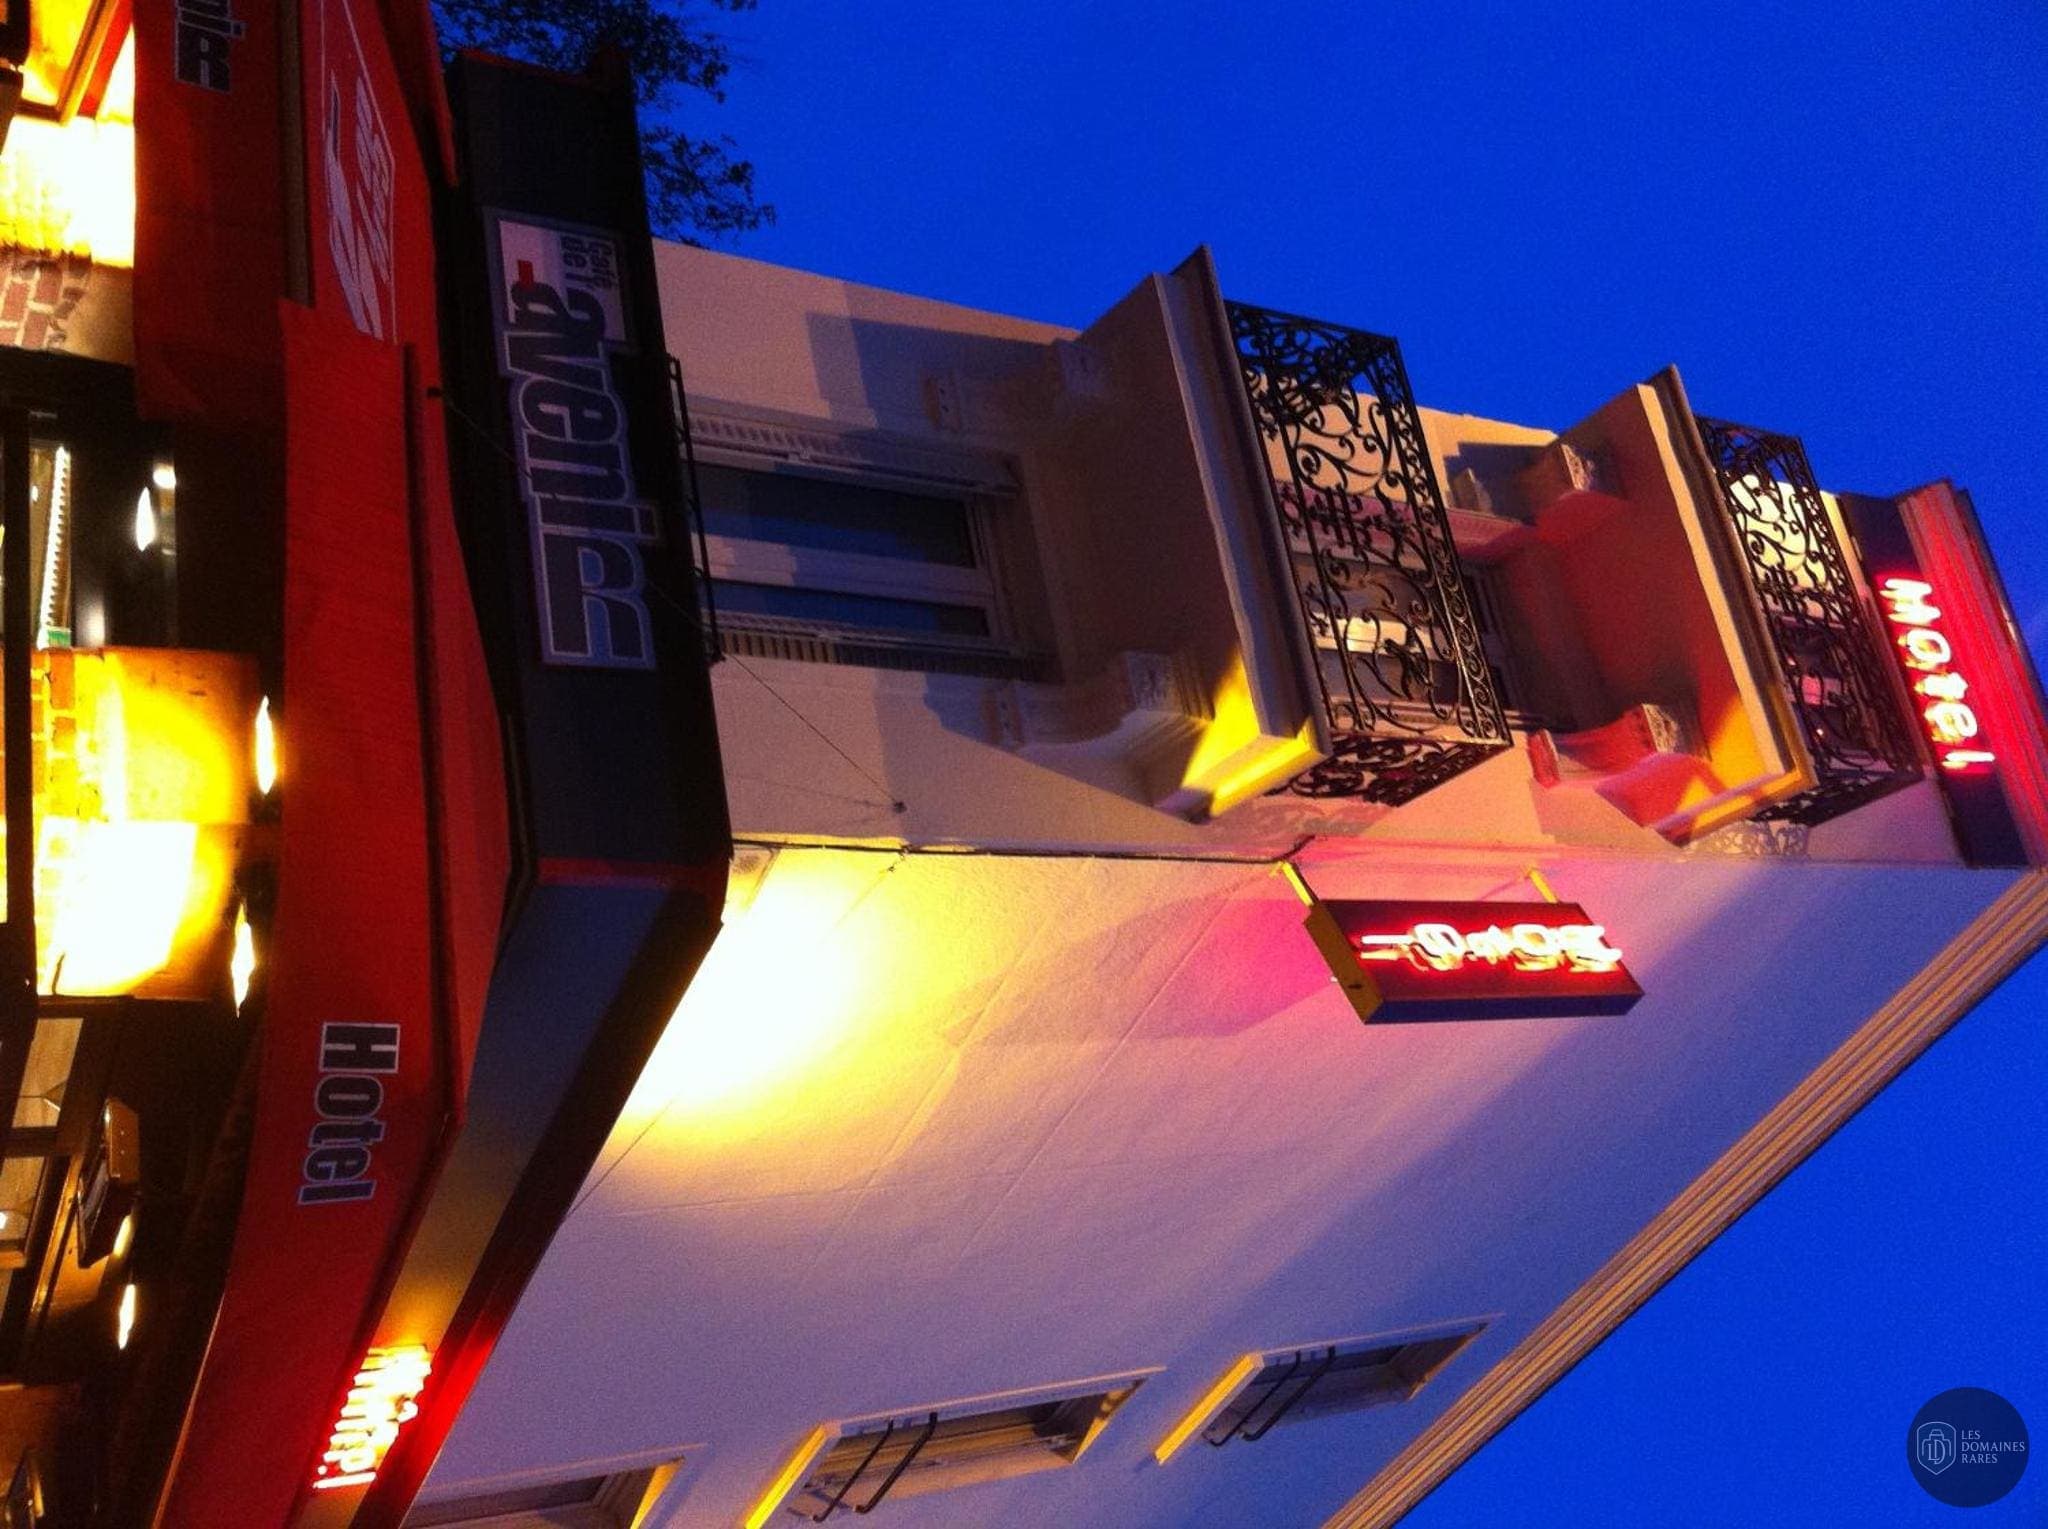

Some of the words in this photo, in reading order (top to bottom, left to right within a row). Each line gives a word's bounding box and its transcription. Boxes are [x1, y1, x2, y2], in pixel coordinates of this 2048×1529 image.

[590, 242, 618, 289] Café
[1880, 578, 1996, 768] Hotel
[1361, 924, 1624, 970] Hotel
[297, 1022, 401, 1205] Hotel
